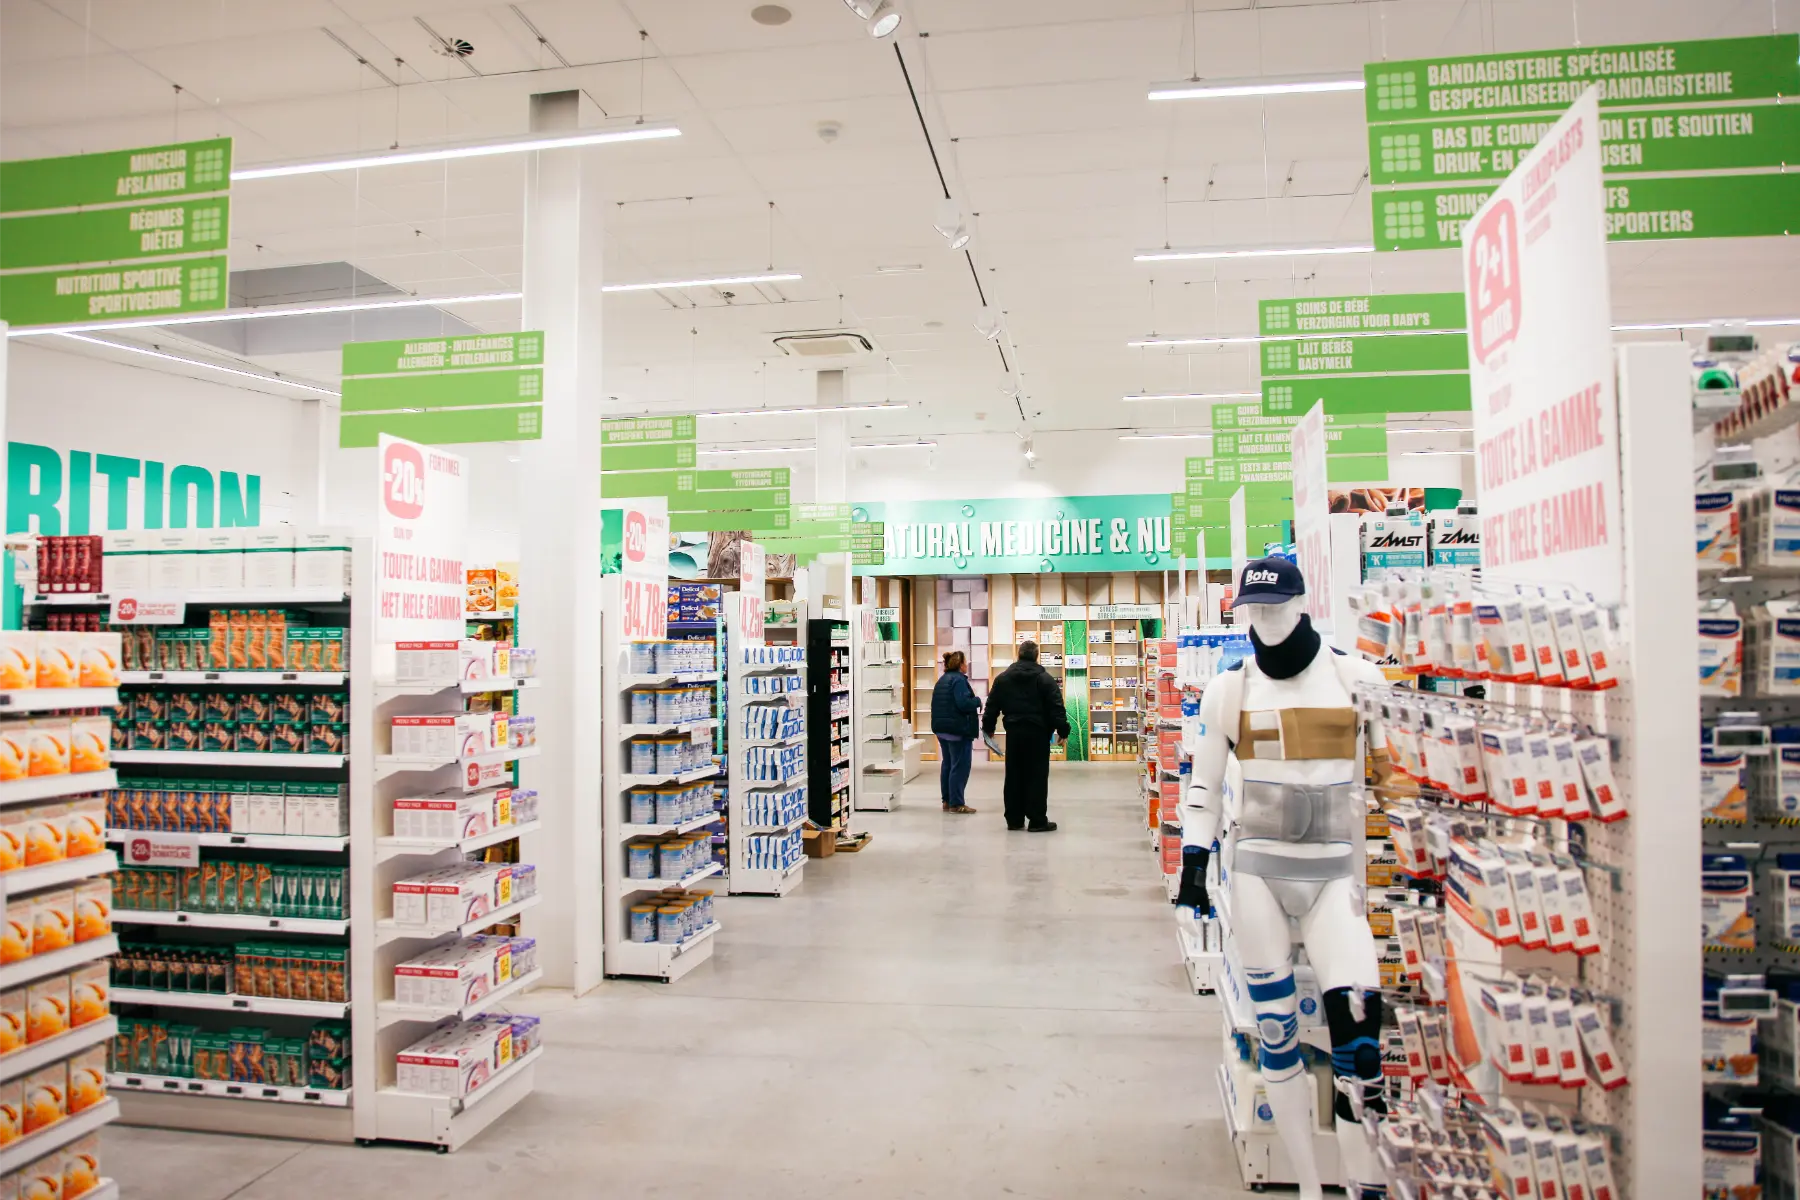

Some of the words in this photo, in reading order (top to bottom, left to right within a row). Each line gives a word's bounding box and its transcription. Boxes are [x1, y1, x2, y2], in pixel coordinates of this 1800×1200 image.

[1427, 56, 1563, 86] BANDAGISTERIE
[1566, 46, 1676, 77] SPÉCIALISÉE
[1597, 72, 1733, 100] BANDAGISTERIE
[1432, 127, 1467, 149] BAS
[1471, 126, 1493, 147] DE
[1627, 117, 1647, 139] ET
[1651, 116, 1674, 138] DE
[1678, 113, 1753, 137] SOUTIEN
[130, 149, 187, 173] MINCEUR
[1433, 151, 1488, 174] DRUK-
[1492, 150, 1514, 172] EN
[116, 171, 186, 196] AFSLANKEN
[130, 207, 184, 230] RÉGIMES
[56, 272, 120, 295] NUTRITION
[122, 267, 182, 290] SPORTIVE
[1296, 301, 1327, 315] SOINS
[1329, 300, 1342, 314] DE
[1296, 315, 1360, 330] VERZORGING
[1298, 342, 1319, 356] LAIT
[1298, 356, 1353, 371] BABYMELK
[1480, 427, 1518, 491] TOUTE
[1520, 418, 1538, 476] LA
[1540, 381, 1604, 468] GAMME
[6, 441, 261, 536] RITION
[1484, 514, 1505, 568] HET
[1508, 503, 1538, 564] HELE
[1541, 481, 1608, 557] GAMMA
[884, 522, 974, 559] ATURAL
[980, 517, 1104, 557] MEDICINE
[1110, 518, 1131, 553] &
[1370, 531, 1423, 548] ZAMST
[383, 552, 413, 580] TOUTE
[416, 556, 427, 581] LA
[430, 557, 463, 585] GAMME
[1246, 569, 1278, 583] Bota
[382, 591, 400, 618] HET
[403, 592, 424, 619] HELE
[427, 594, 461, 620] GAMMA
